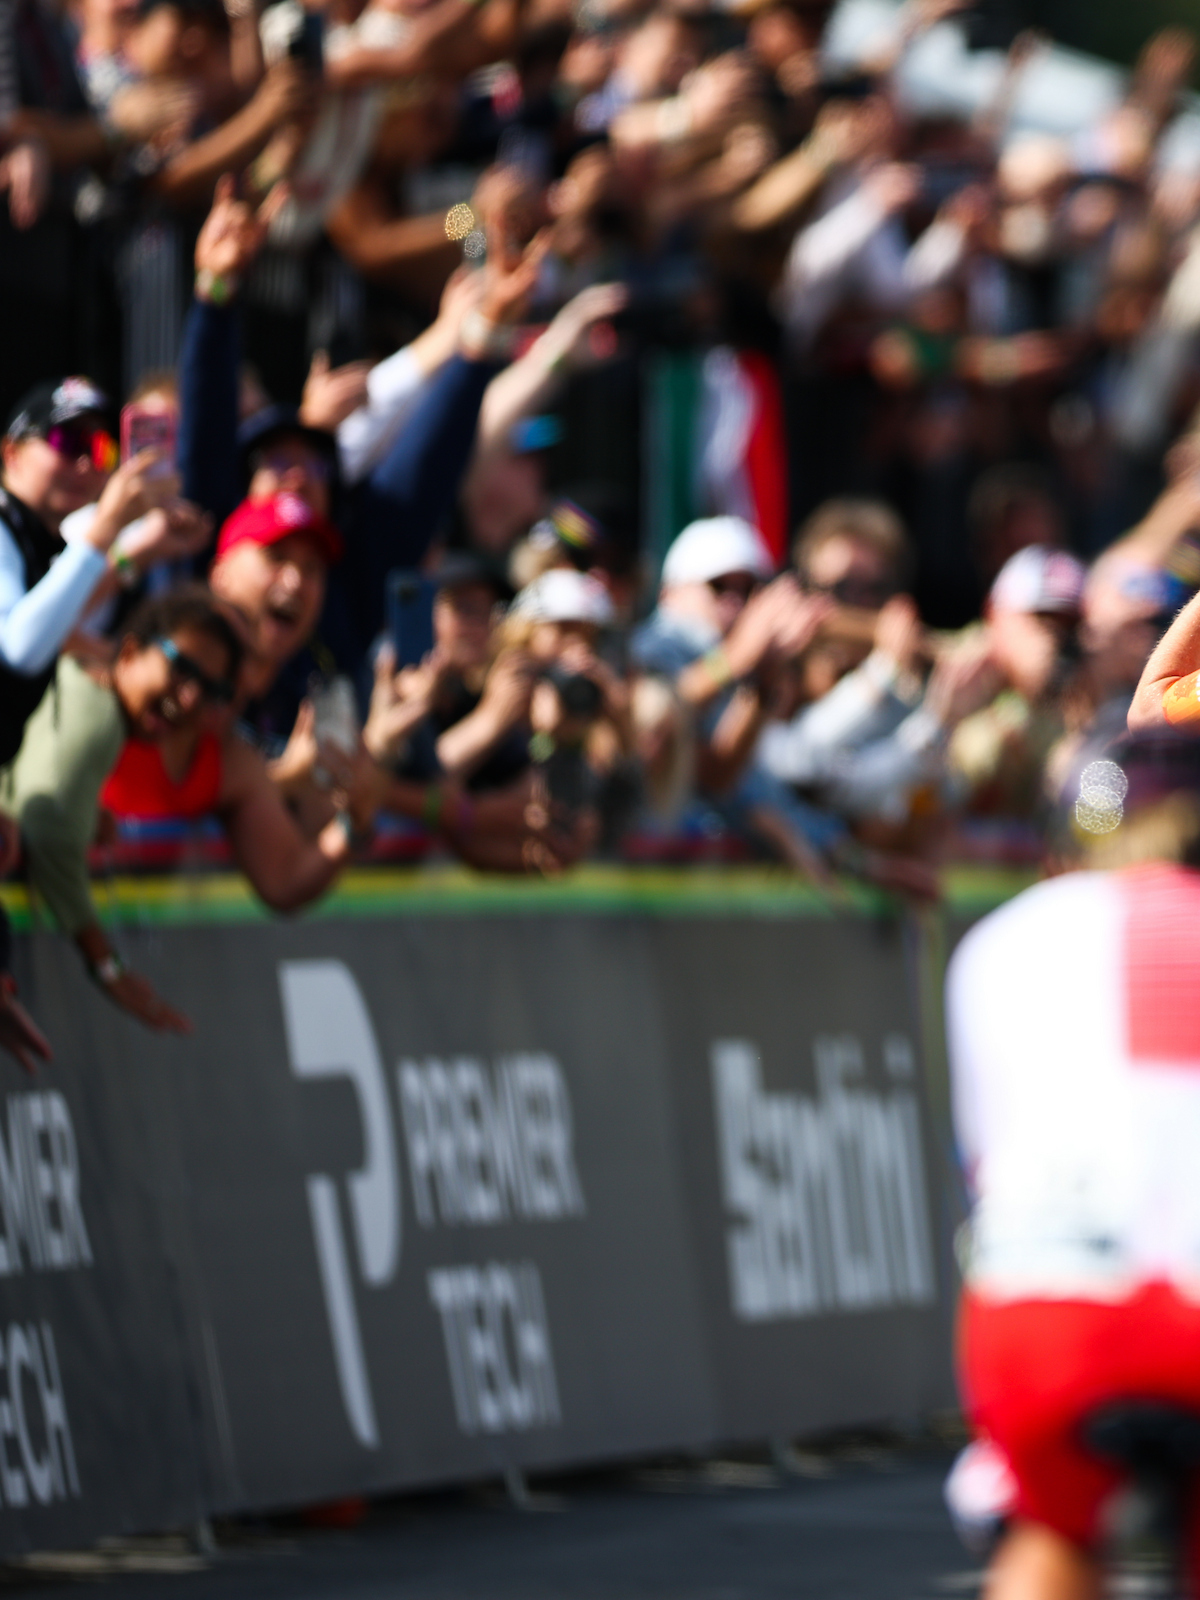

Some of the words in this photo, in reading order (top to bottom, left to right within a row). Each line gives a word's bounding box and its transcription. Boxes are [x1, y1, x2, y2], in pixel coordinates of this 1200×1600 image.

[0, 1090, 95, 1275] MIER
[398, 1051, 588, 1228] PREMIER
[0, 1318, 82, 1508] ECH
[426, 1261, 563, 1435] TECH
